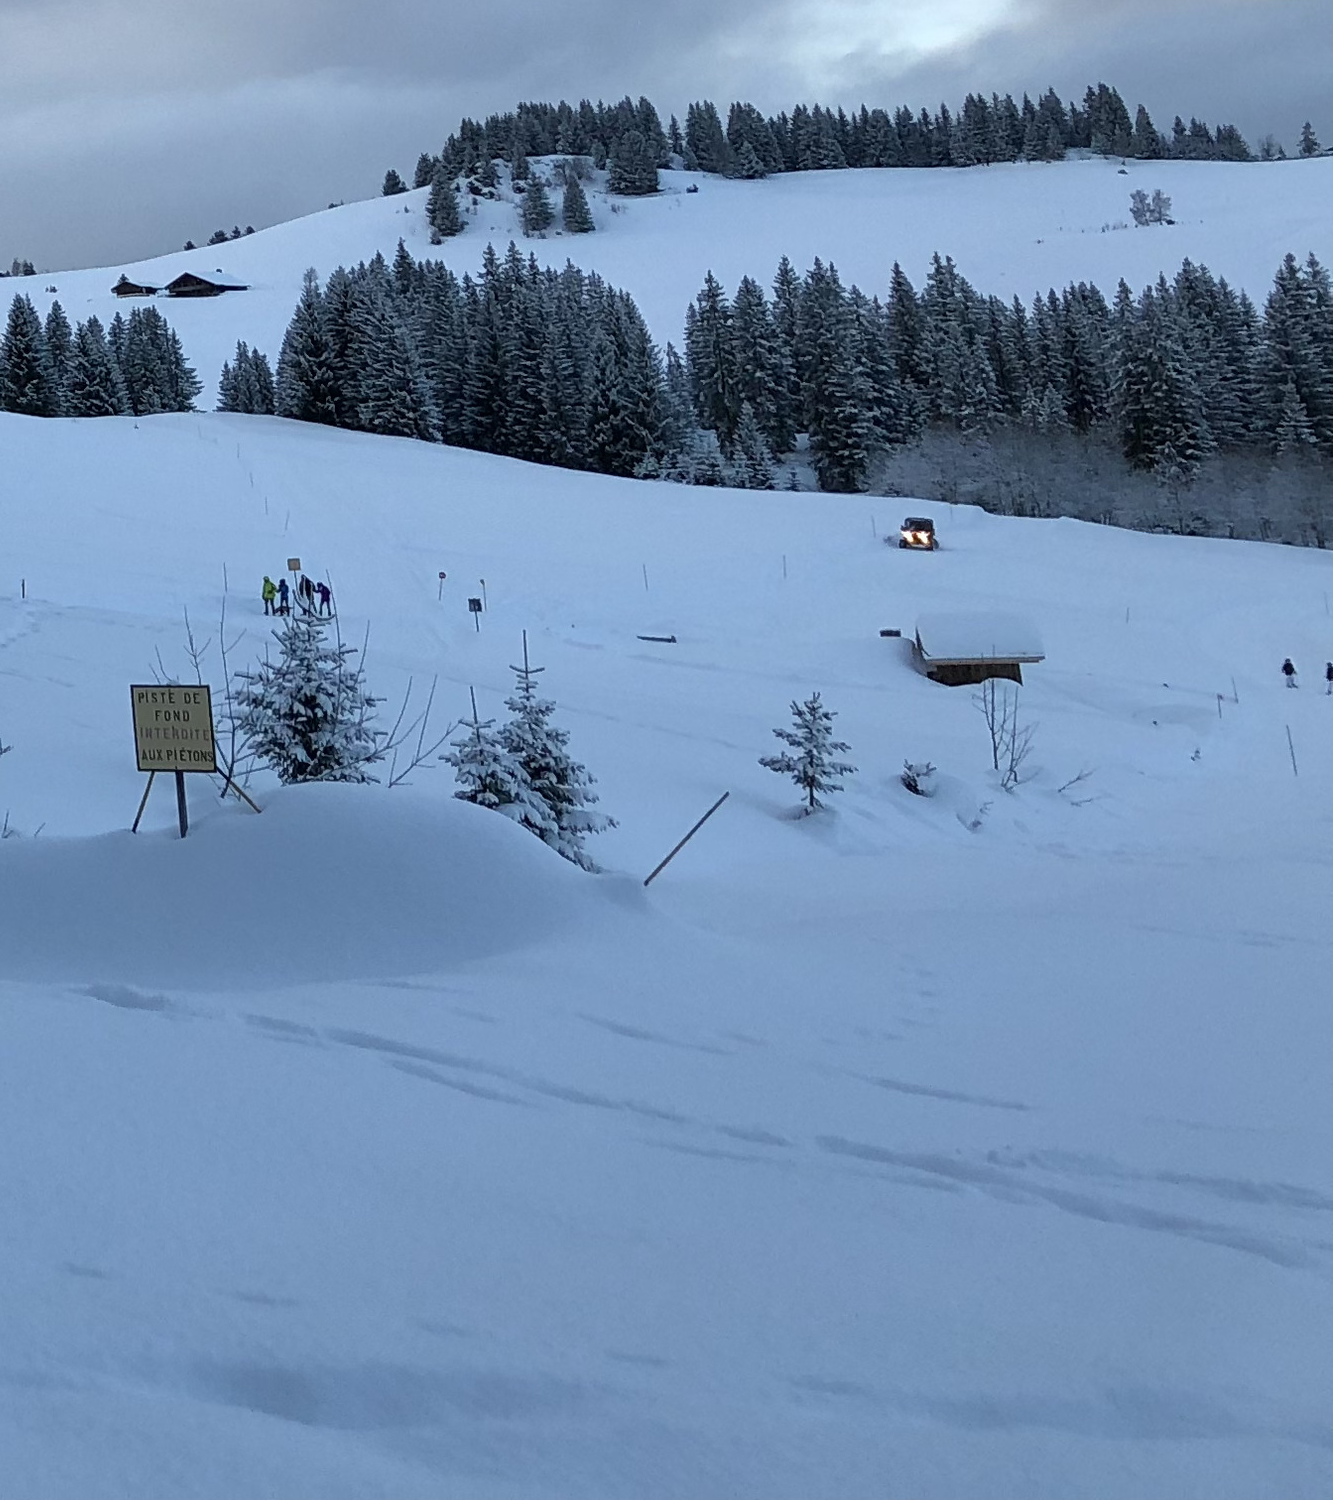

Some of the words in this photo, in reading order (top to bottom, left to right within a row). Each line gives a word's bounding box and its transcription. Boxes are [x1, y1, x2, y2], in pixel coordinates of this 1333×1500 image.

[138, 691, 175, 704] PISTE
[184, 692, 201, 704] DE
[155, 710, 190, 722] FOND
[140, 728, 211, 741] INTERDITE
[141, 749, 164, 762] AUX
[166, 747, 214, 762] PIÉTONS
